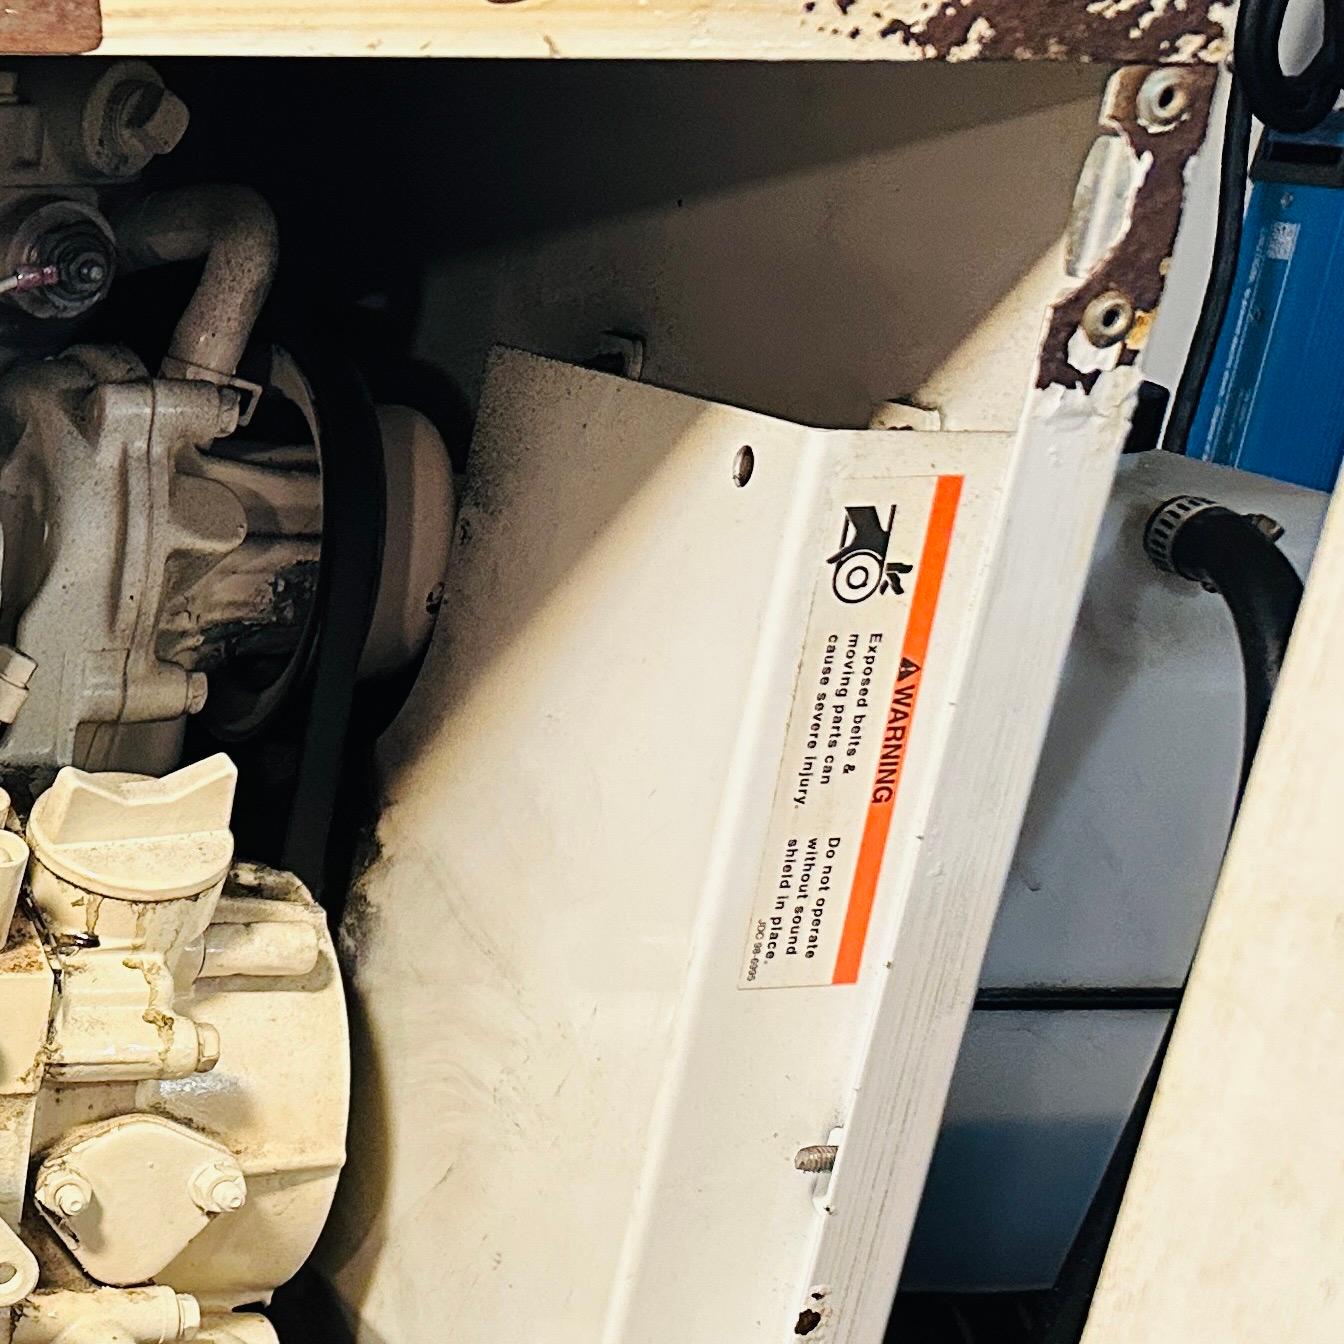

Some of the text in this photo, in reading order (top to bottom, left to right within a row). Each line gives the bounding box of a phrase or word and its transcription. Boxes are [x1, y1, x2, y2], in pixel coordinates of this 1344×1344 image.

[793, 635, 839, 809] cause severe injury.
[819, 634, 860, 784] moving parts can
[842, 633, 883, 774] Exposed belts &
[871, 685, 915, 803] WARNING
[763, 839, 798, 964] shield in place.
[785, 838, 819, 955] without sound
[804, 837, 840, 958] Do not operate
